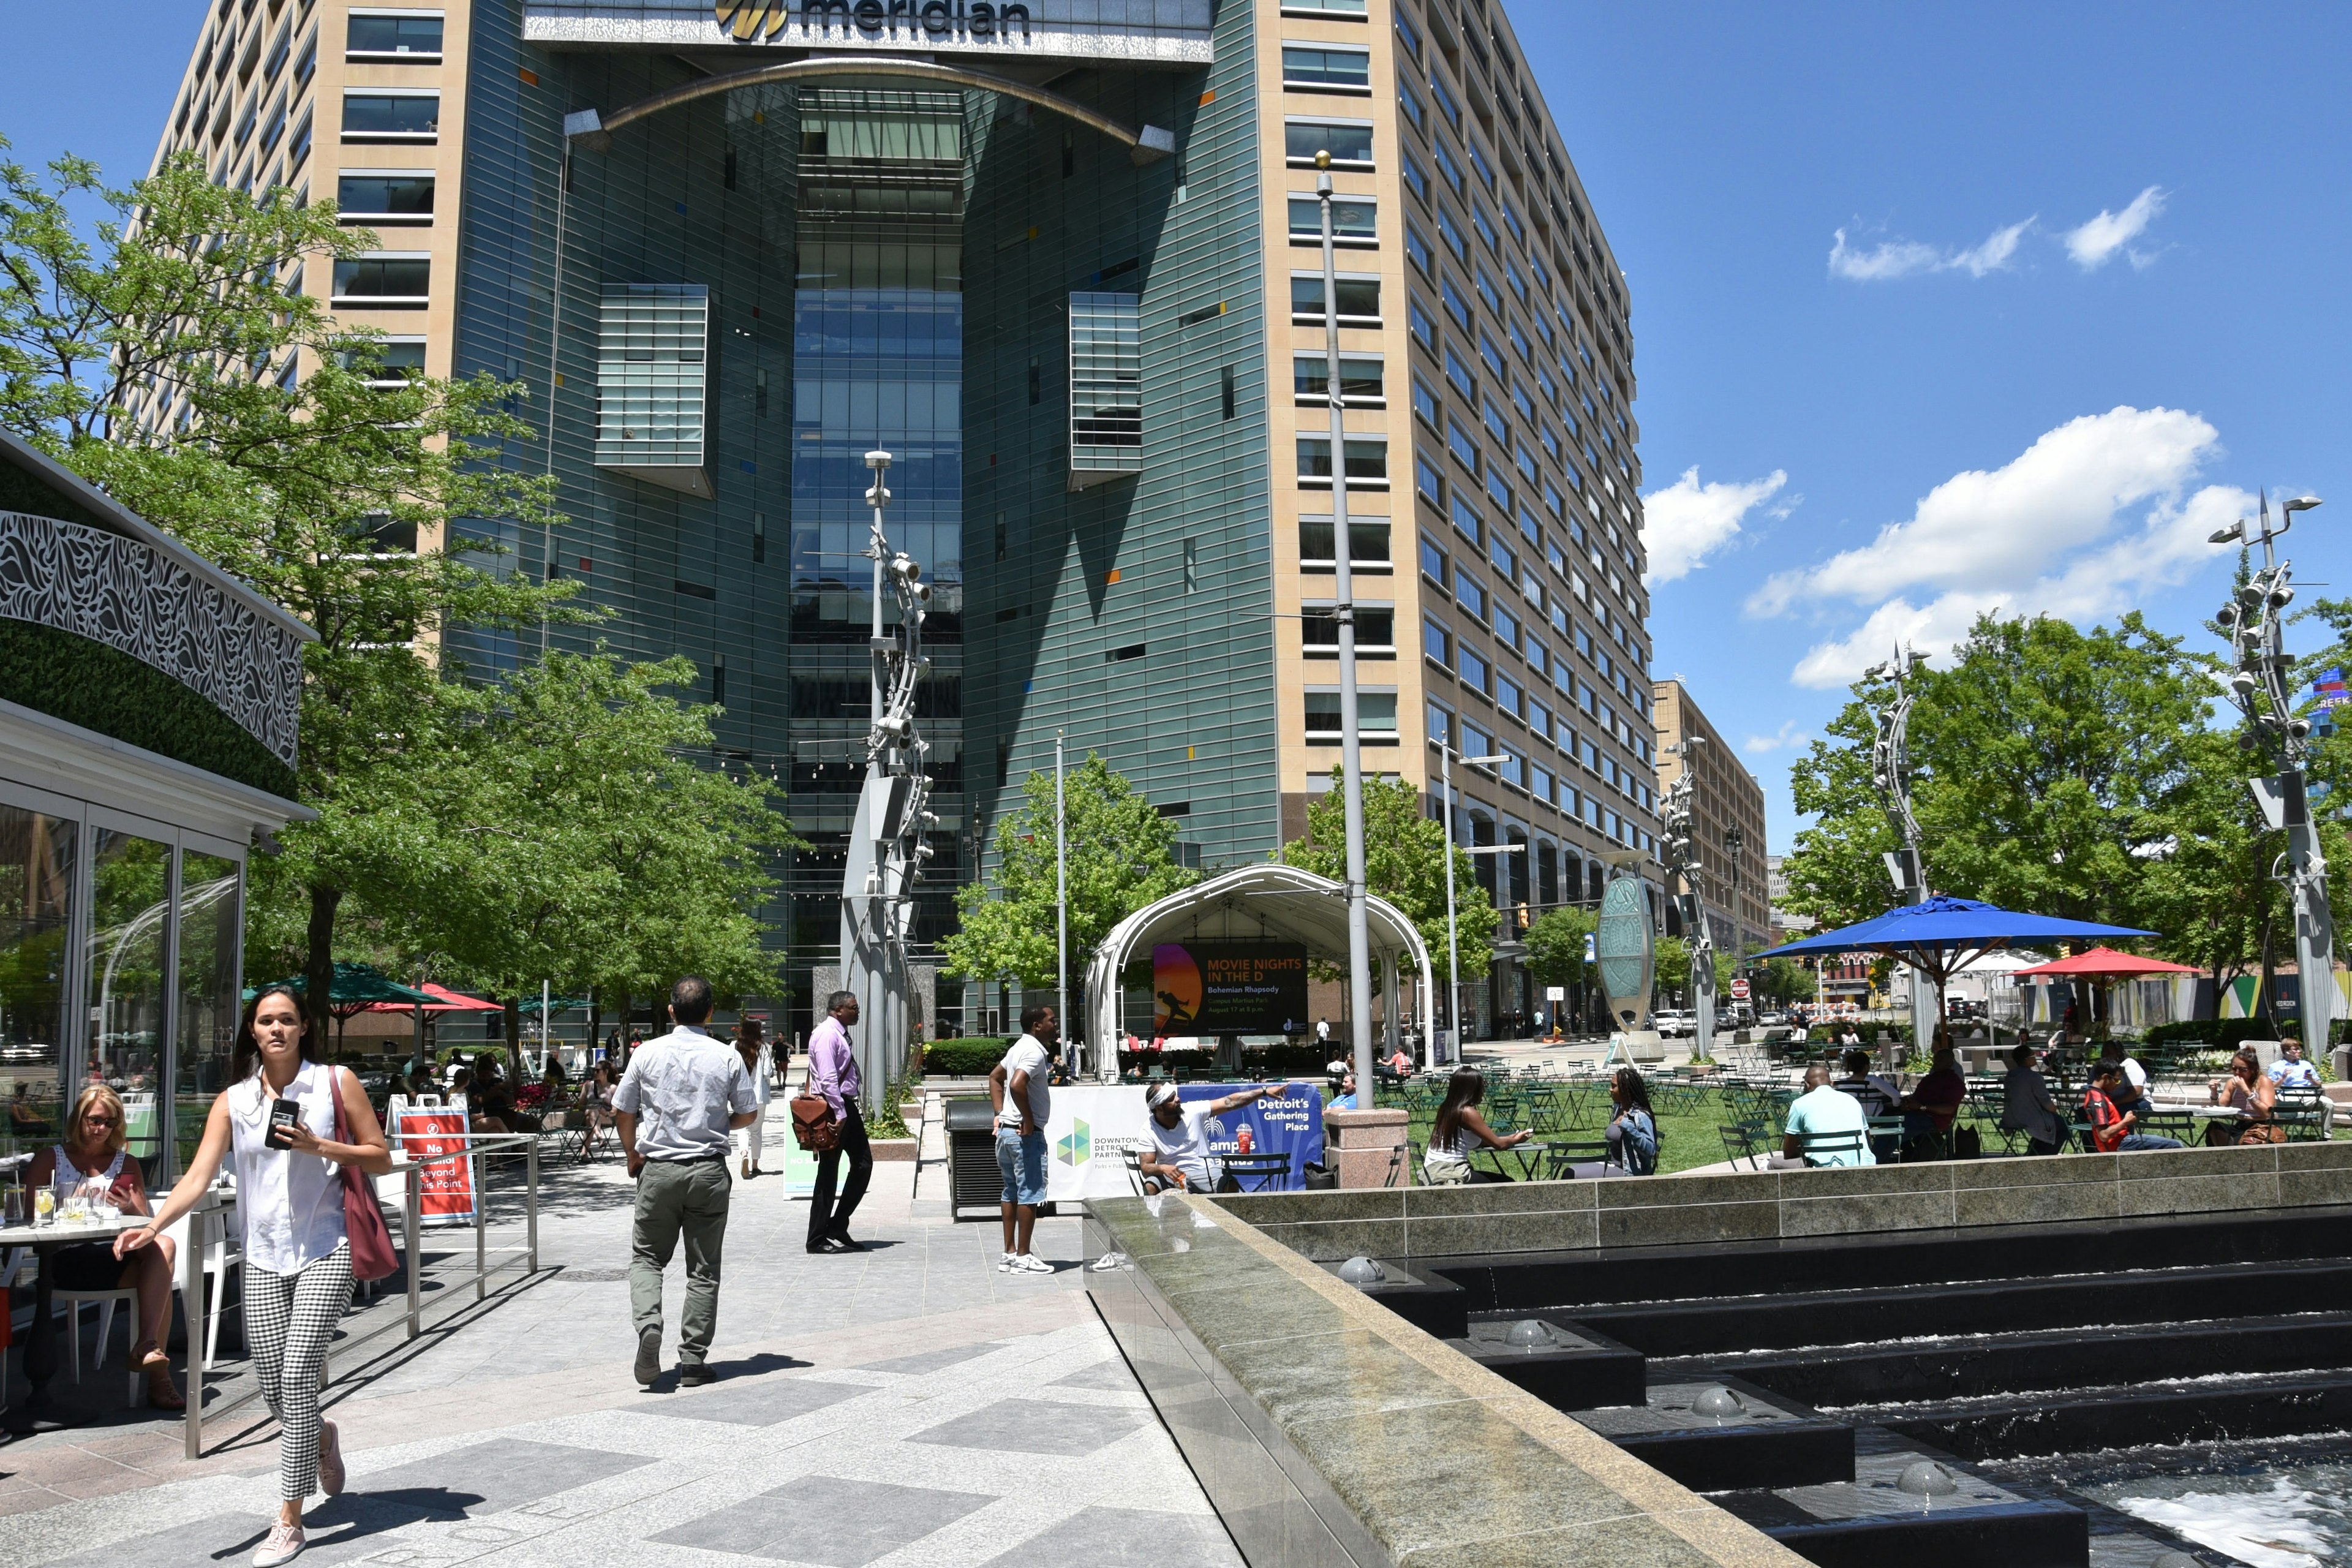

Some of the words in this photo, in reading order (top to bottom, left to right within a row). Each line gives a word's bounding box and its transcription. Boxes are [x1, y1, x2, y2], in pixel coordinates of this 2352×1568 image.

[801, 0, 1030, 35] meridian
[1208, 959, 1250, 970] MOVIE
[1254, 958, 1302, 970] NIGHTS
[1208, 972, 1221, 982] IN
[1226, 971, 1250, 982] THE
[1254, 971, 1264, 981] D
[1245, 985, 1280, 994] Rhapsody
[1257, 1098, 1309, 1109] Detroit's
[1264, 1112, 1309, 1121] Gathering
[1285, 1123, 1310, 1131] Place
[426, 1144, 443, 1153] No
[1208, 1140, 1256, 1153] amps
[420, 1180, 434, 1189] his
[436, 1179, 462, 1189] Point
